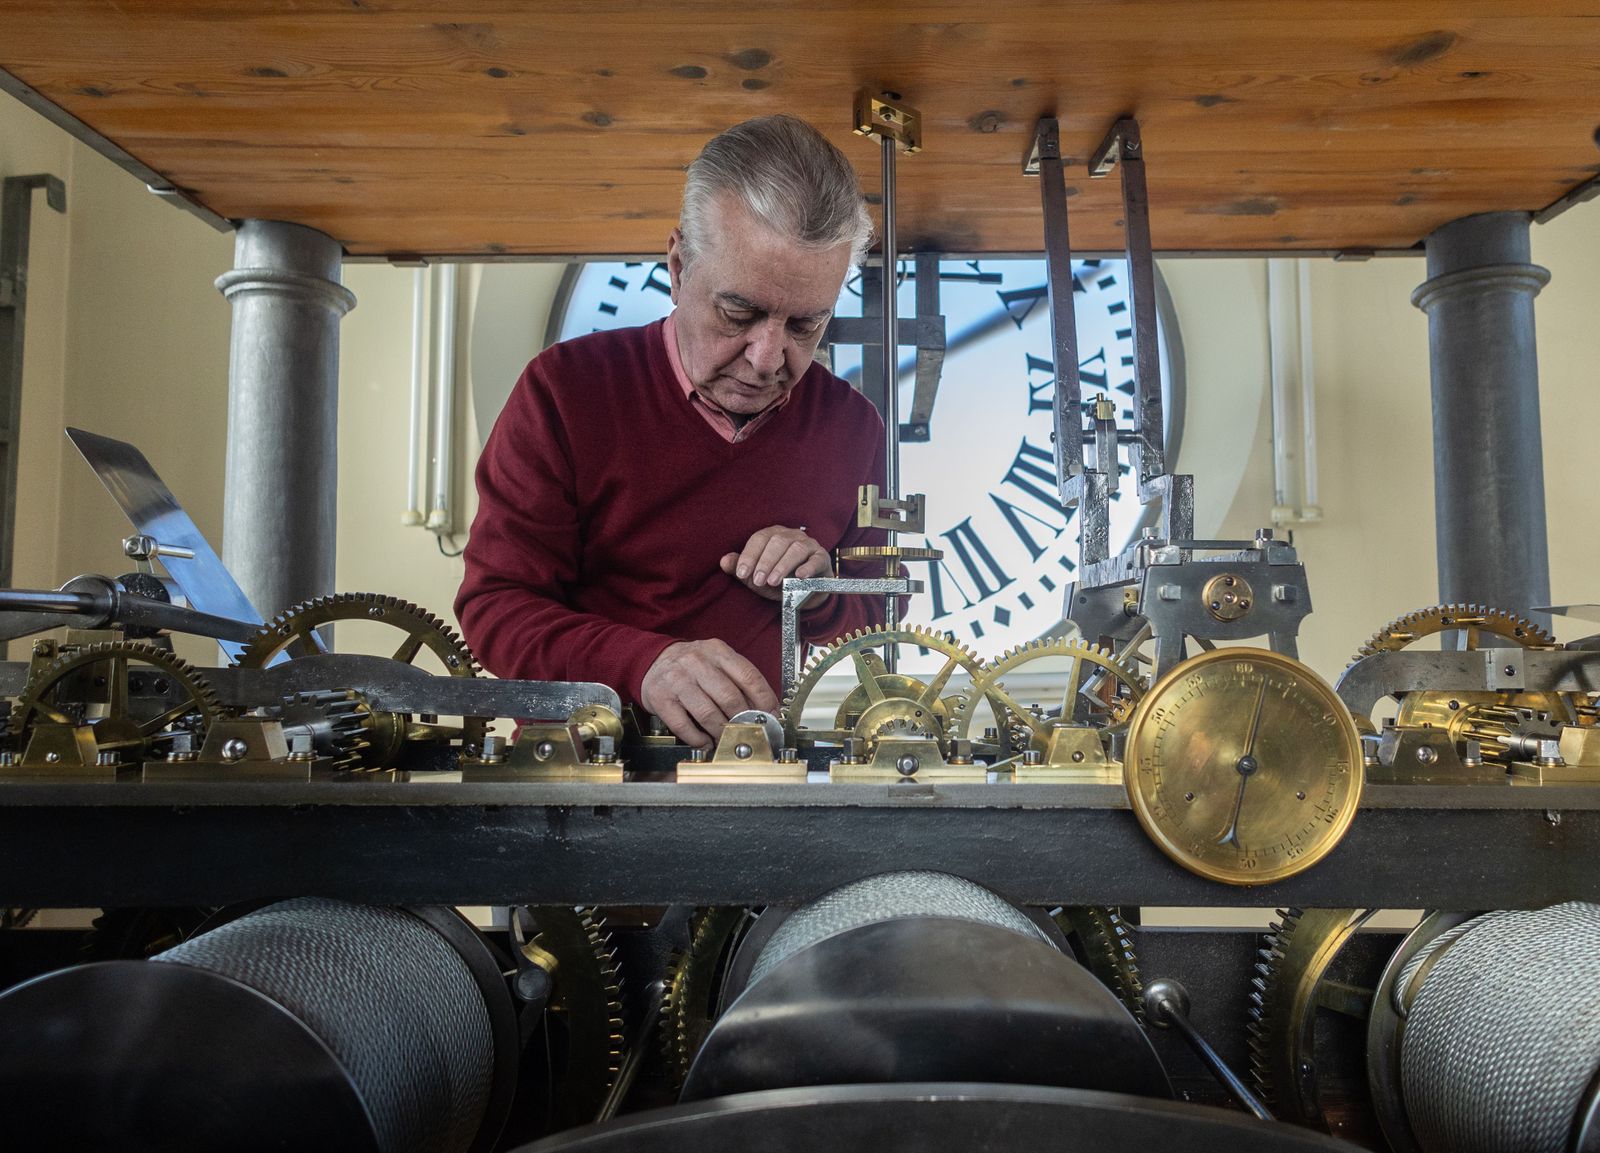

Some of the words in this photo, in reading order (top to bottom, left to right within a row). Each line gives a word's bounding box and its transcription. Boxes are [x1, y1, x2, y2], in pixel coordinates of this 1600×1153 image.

[1235, 663, 1254, 673] 60
[1186, 673, 1203, 688] 55
[1151, 707, 1166, 725] 50
[1324, 806, 1339, 824] 20
[1287, 843, 1304, 859] 25
[1239, 858, 1256, 869] 30
